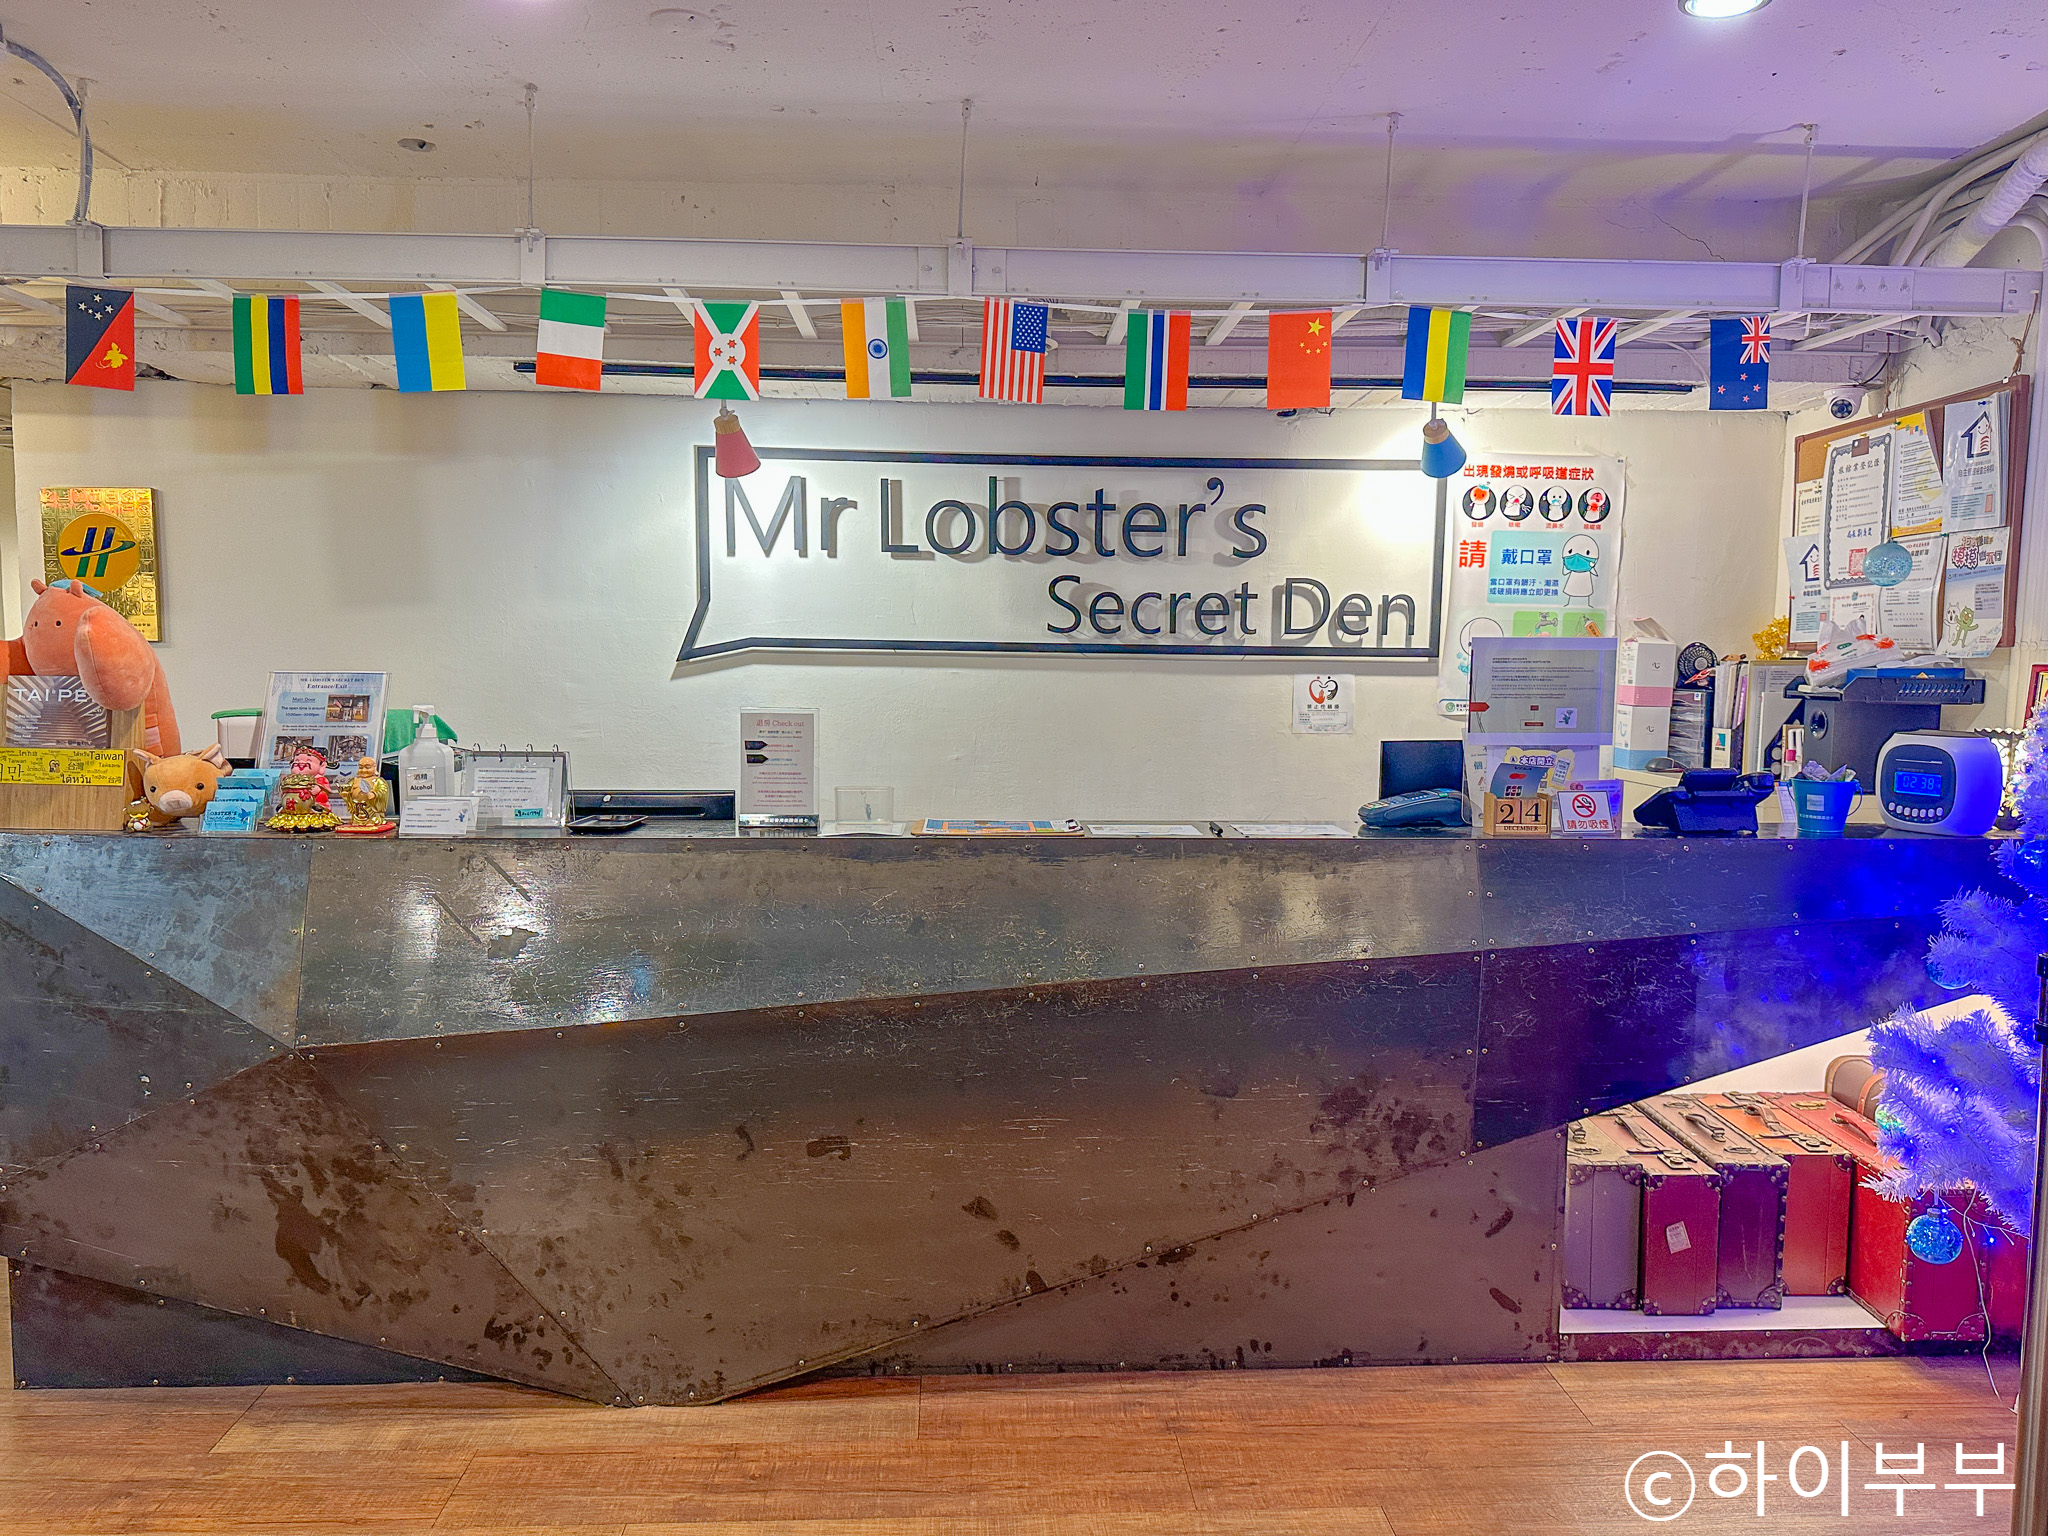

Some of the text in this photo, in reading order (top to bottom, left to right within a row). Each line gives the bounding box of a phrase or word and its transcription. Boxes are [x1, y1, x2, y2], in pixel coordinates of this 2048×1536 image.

[1463, 464, 1594, 481] 出現發燒或呼吸道症狀
[725, 476, 1268, 558] Mr Lobster's
[1459, 540, 1487, 568] 請
[1501, 548, 1552, 565] 戴口罩
[1047, 575, 1415, 635] Secret Den
[772, 719, 792, 727] Check
[88, 751, 123, 760] Taiwan
[0, 763, 24, 781] 만
[1567, 819, 1609, 829] 請勿吸煙
